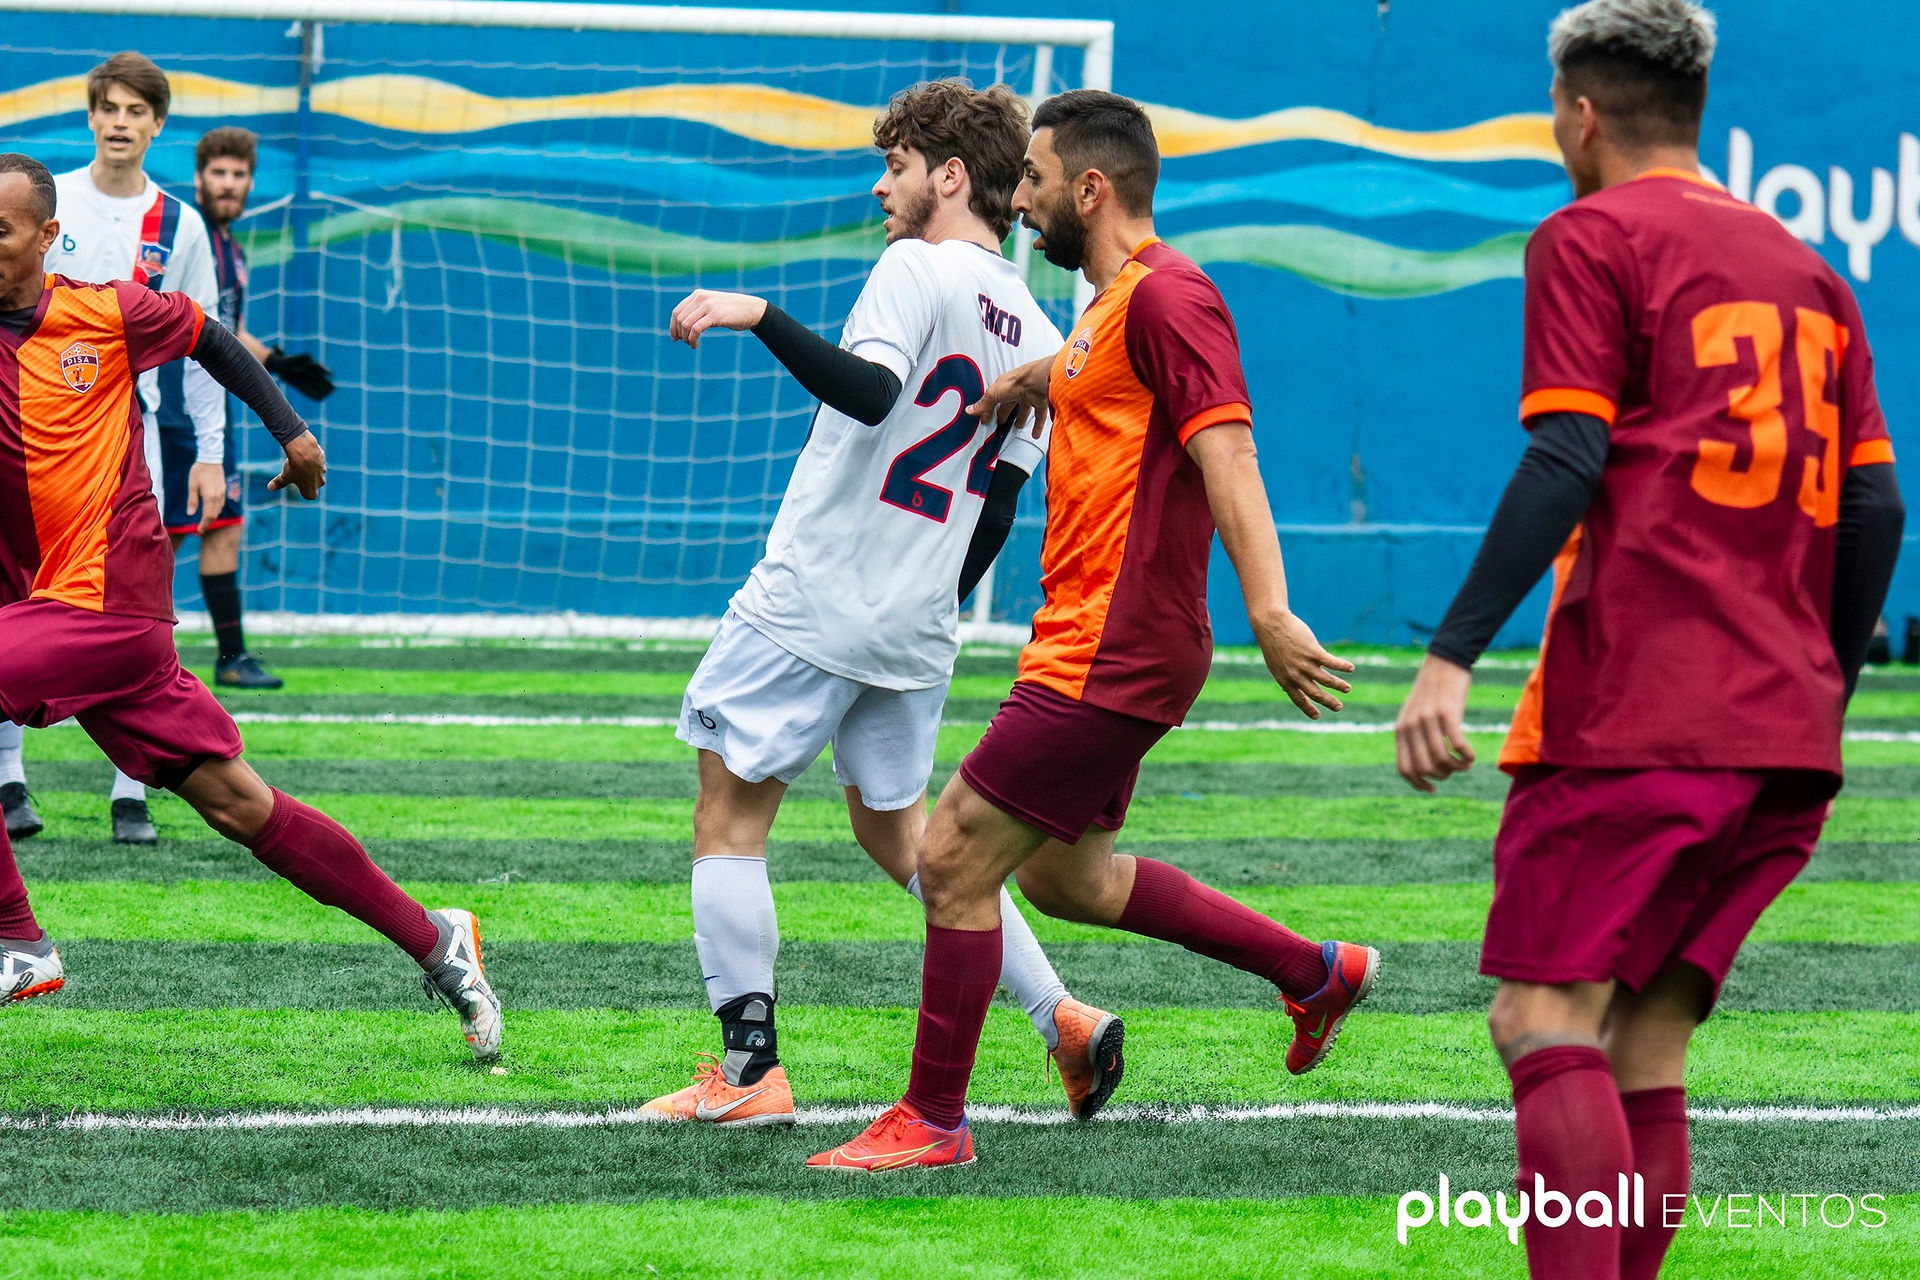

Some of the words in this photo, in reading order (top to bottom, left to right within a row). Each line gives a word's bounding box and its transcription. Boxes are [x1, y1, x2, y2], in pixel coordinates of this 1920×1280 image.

[1698, 126, 1920, 283] lay
[67, 356, 89, 366] PISA
[1690, 300, 1849, 528] 35
